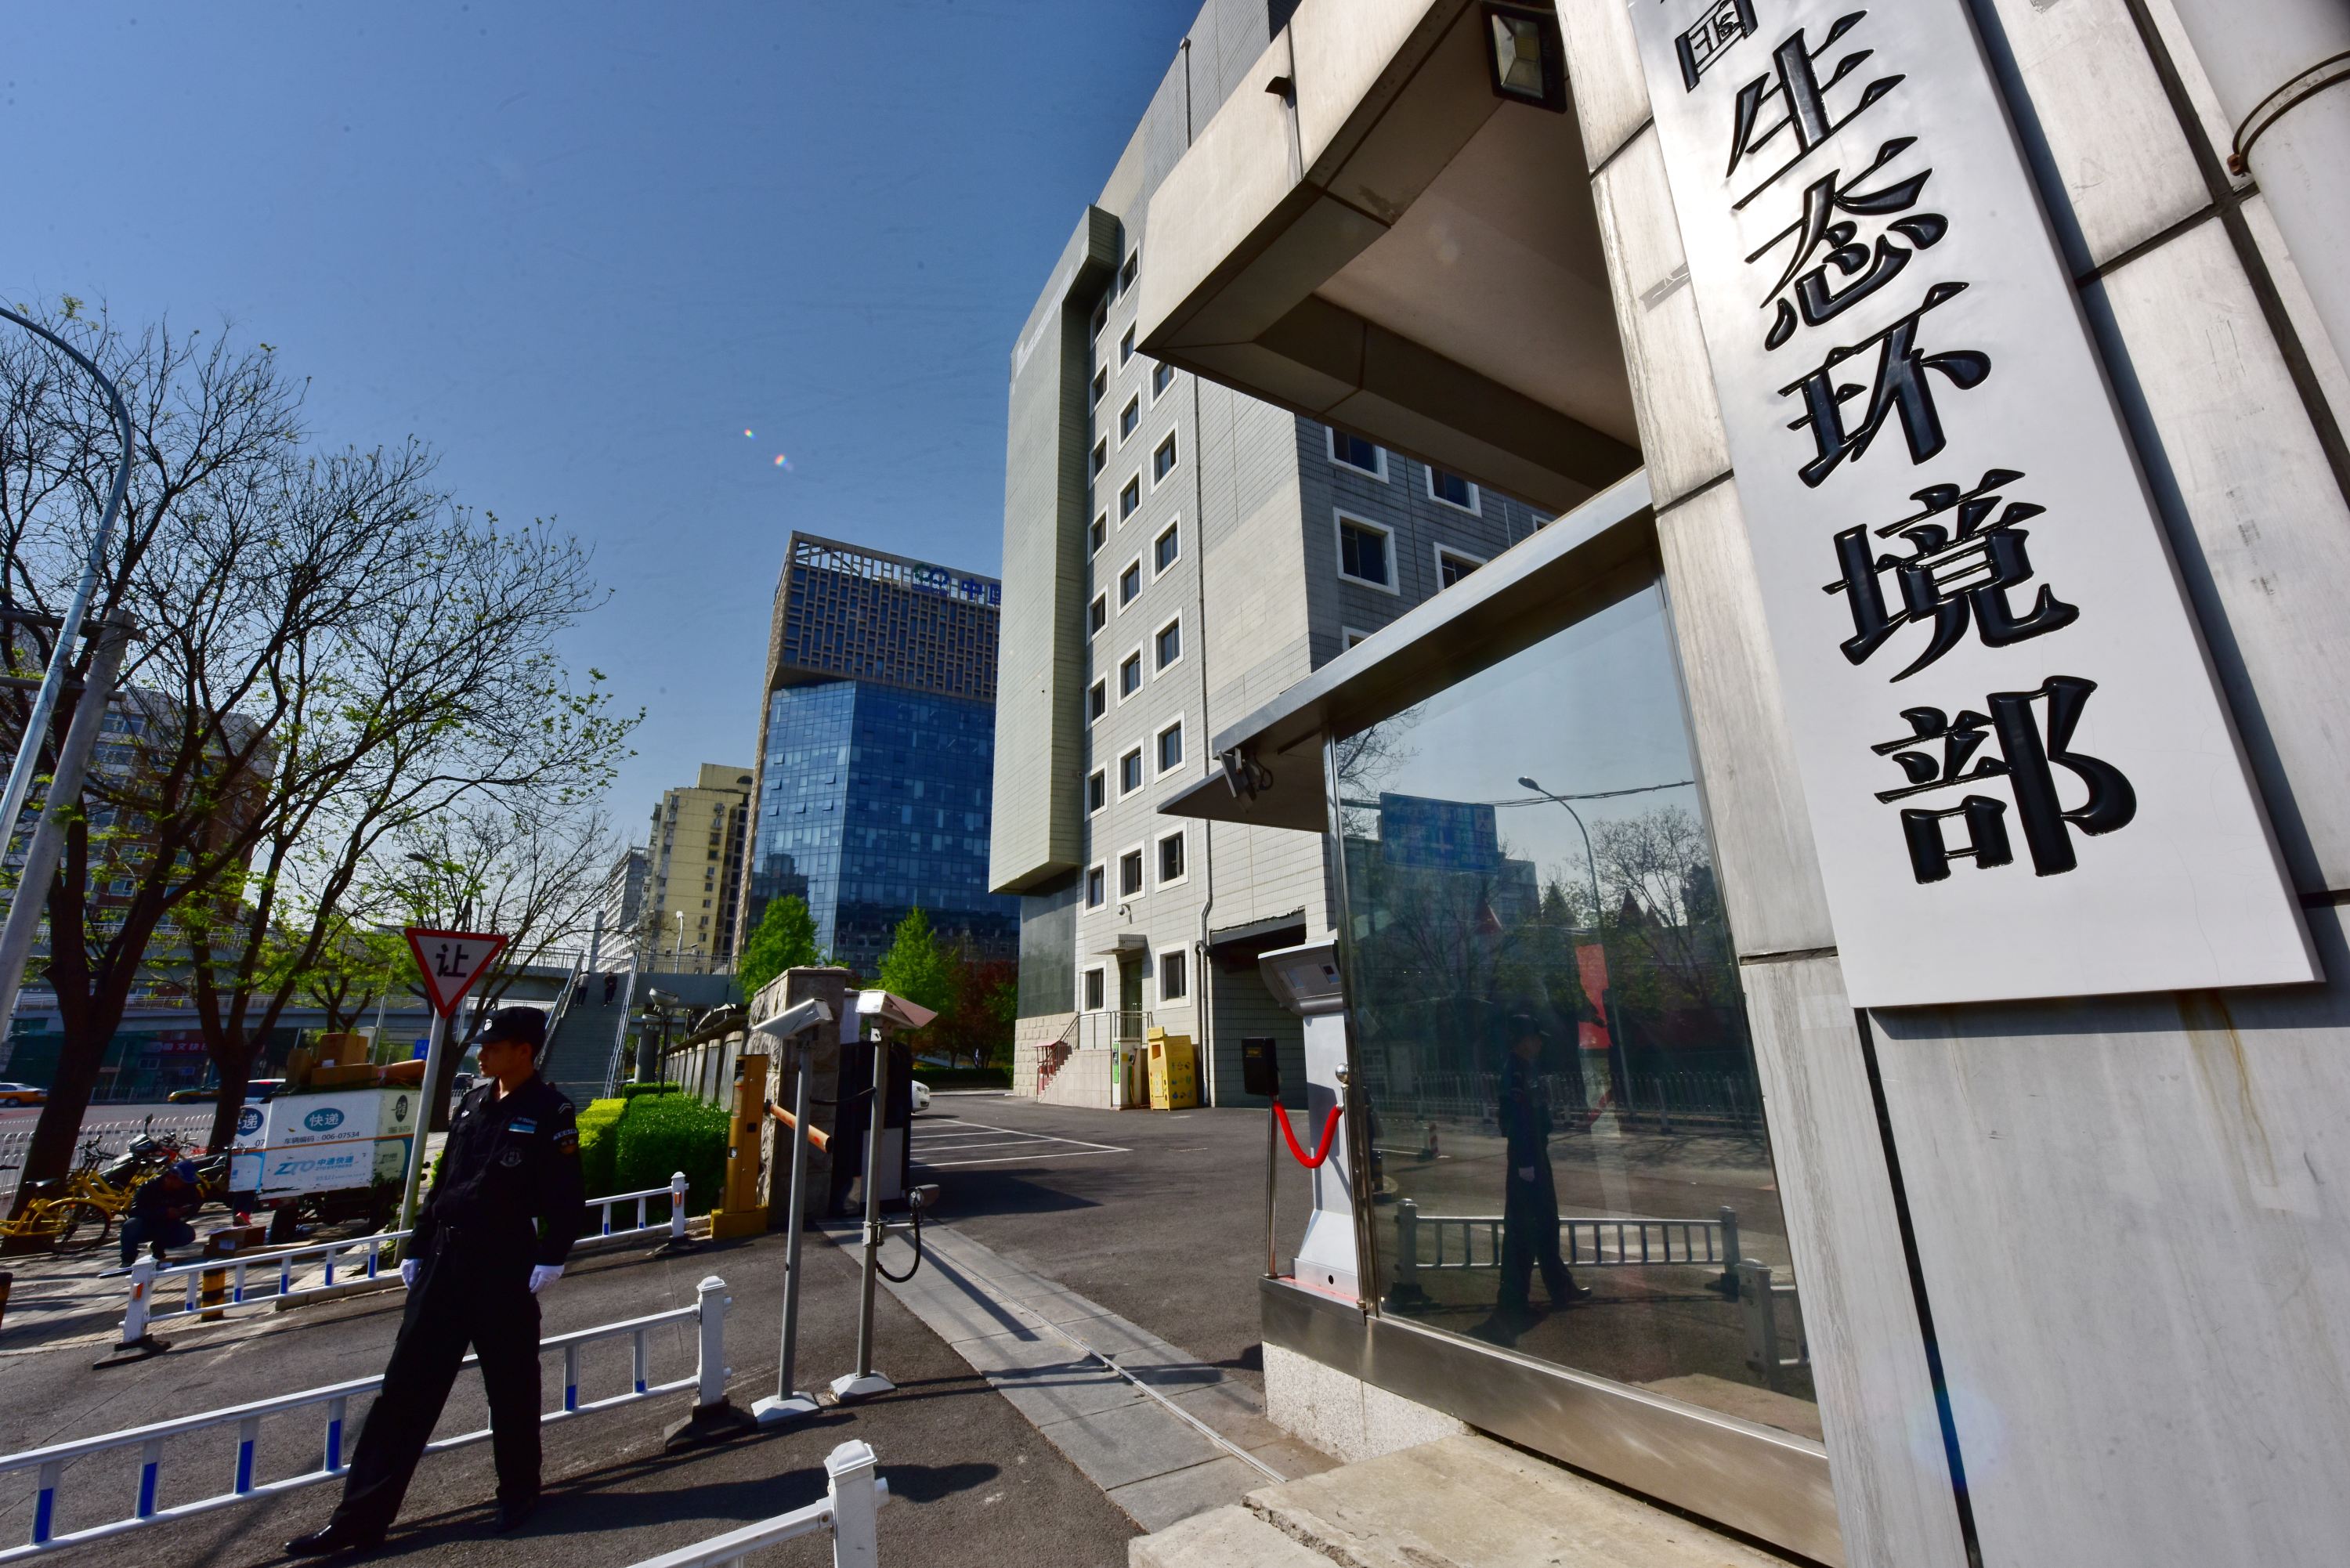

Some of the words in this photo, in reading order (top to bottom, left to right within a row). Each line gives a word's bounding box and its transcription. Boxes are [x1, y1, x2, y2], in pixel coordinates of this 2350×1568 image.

[1661, 0, 2137, 885] 国生态环境部
[436, 943, 469, 977] 让
[237, 1113, 258, 1130] 递
[309, 1112, 339, 1127] 快递
[274, 1161, 315, 1175] ZTO
[317, 1155, 354, 1166] 中通快递
